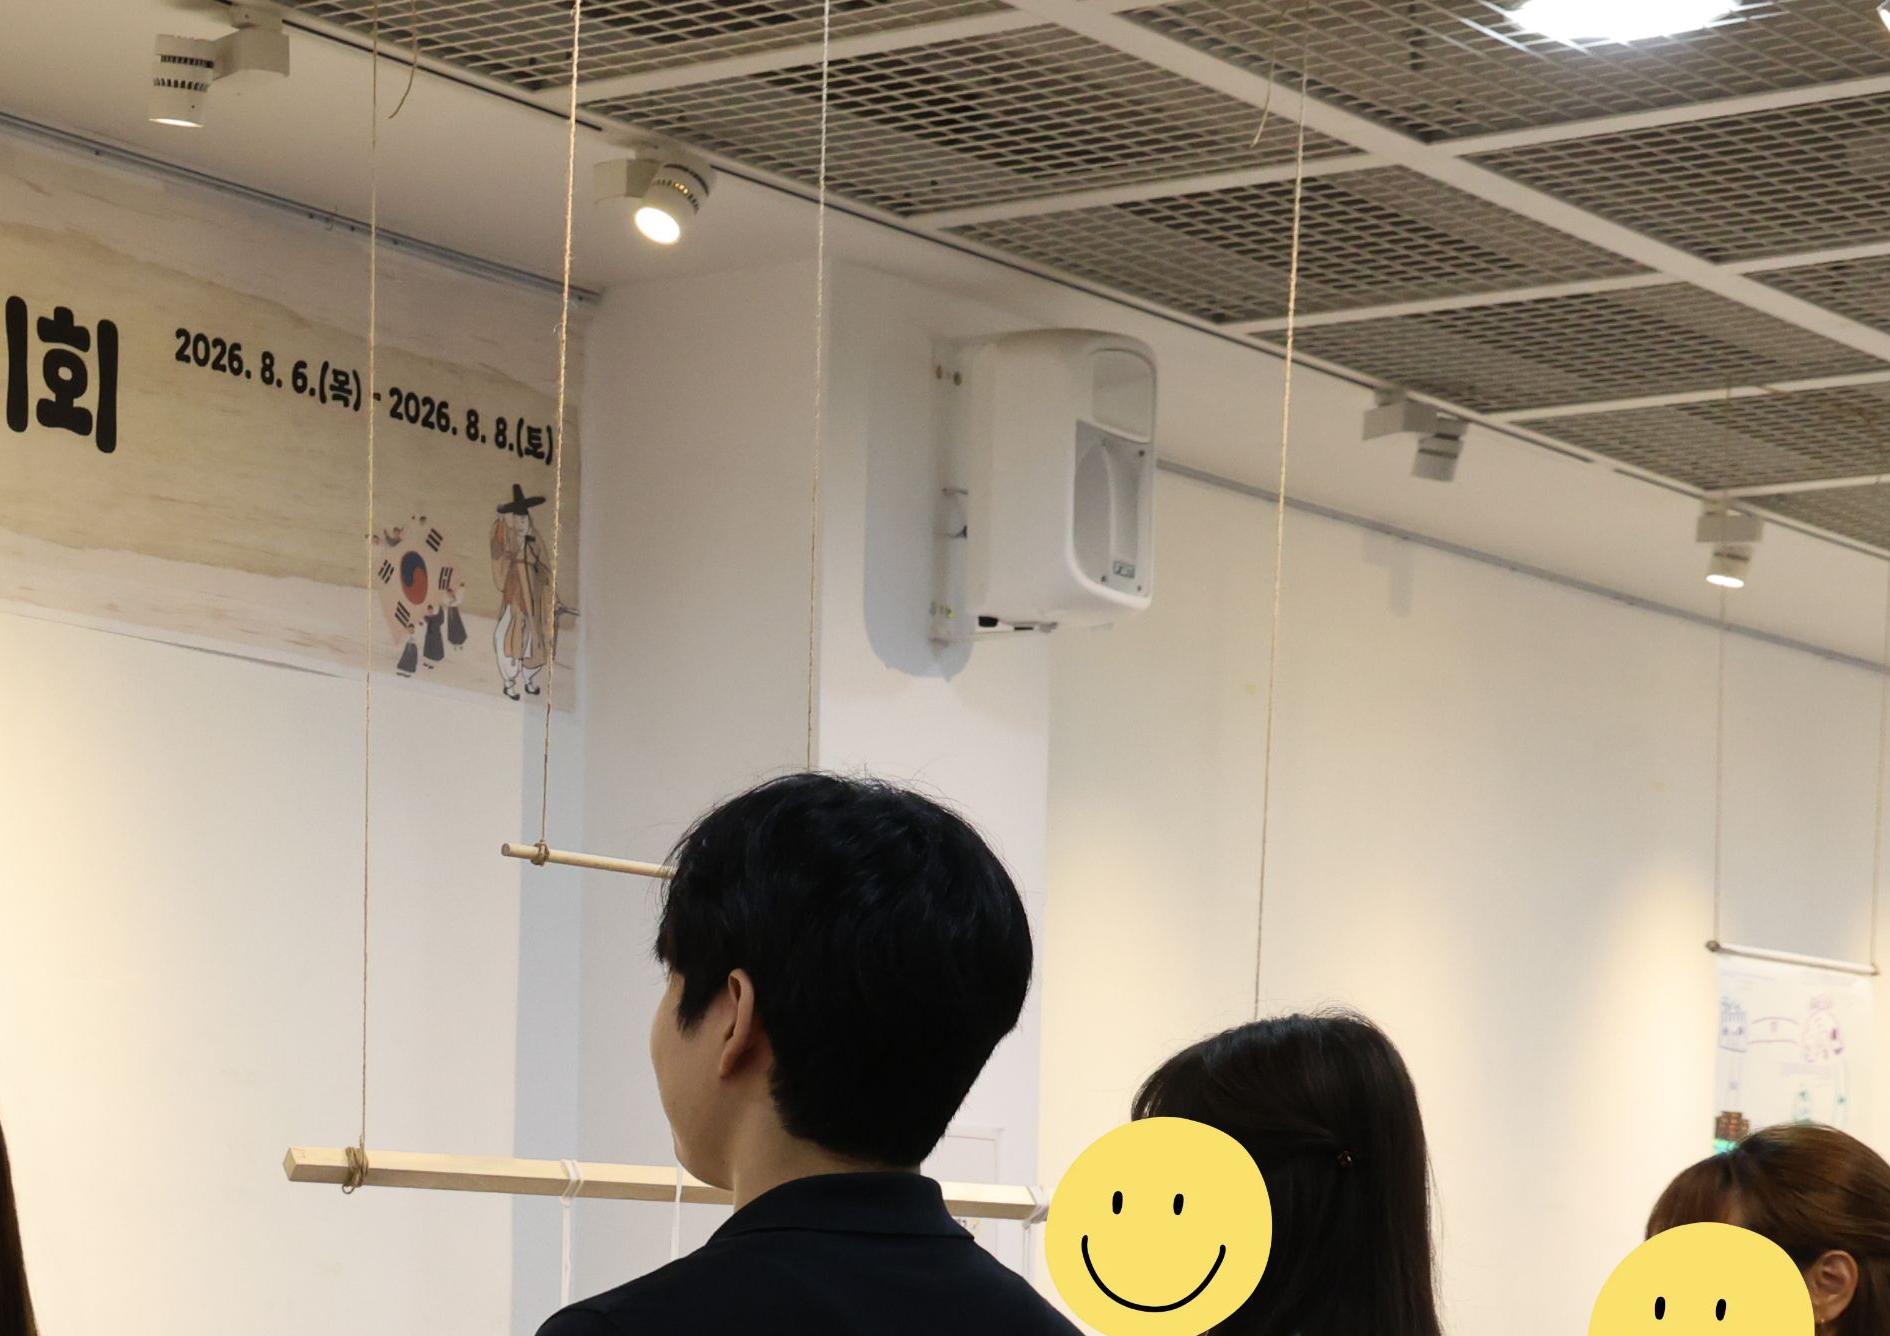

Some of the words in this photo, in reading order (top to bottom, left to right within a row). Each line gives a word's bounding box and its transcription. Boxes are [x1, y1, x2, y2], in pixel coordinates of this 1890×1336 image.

[175, 328, 252, 379] 2026.
[261, 351, 282, 388] 8.
[292, 360, 362, 411] 6.(목)
[389, 387, 458, 435] 2026.
[466, 409, 486, 443] 8.
[495, 417, 553, 465] 8.(토)
